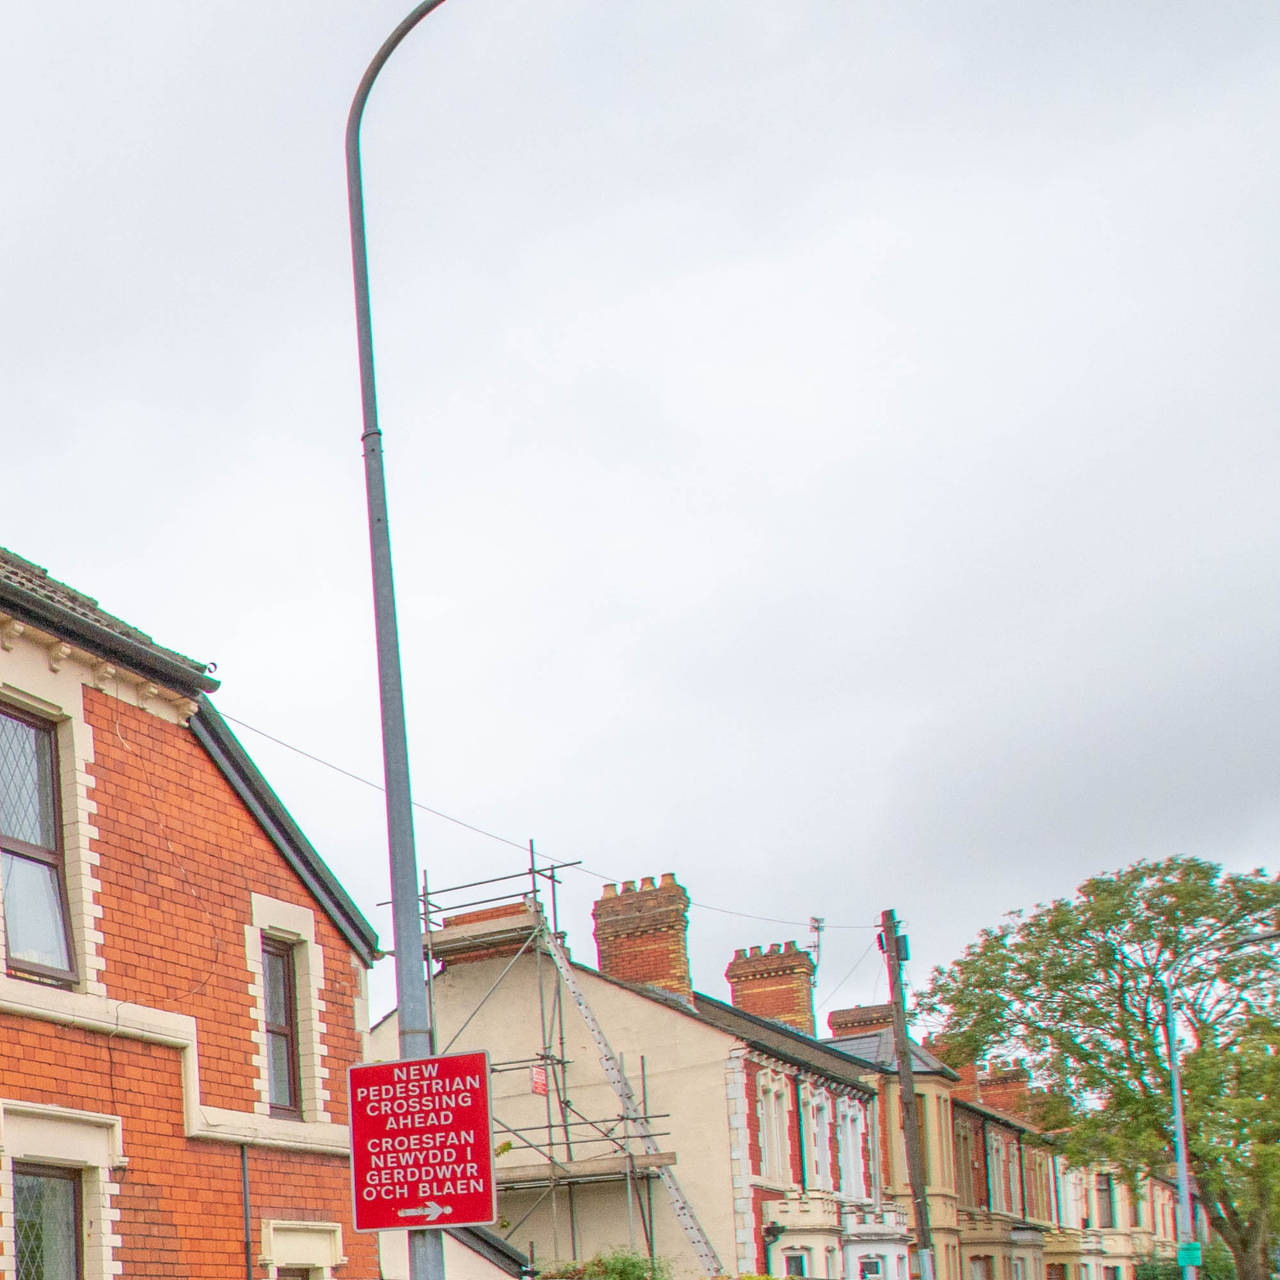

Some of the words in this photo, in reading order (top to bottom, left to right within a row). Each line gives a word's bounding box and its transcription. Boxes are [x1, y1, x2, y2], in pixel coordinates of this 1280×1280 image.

[393, 1063, 439, 1081] NEW
[357, 1075, 480, 1101] PEDESTRIAN
[366, 1092, 472, 1116] CROSSING
[385, 1111, 453, 1130] AHEAD
[367, 1130, 475, 1152] CROESFAN
[370, 1148, 457, 1169] NEWYDD
[466, 1146, 472, 1161] I
[365, 1163, 478, 1185] GERDDWYR
[363, 1183, 409, 1201] O'CH
[418, 1179, 484, 1197] BLAEN
